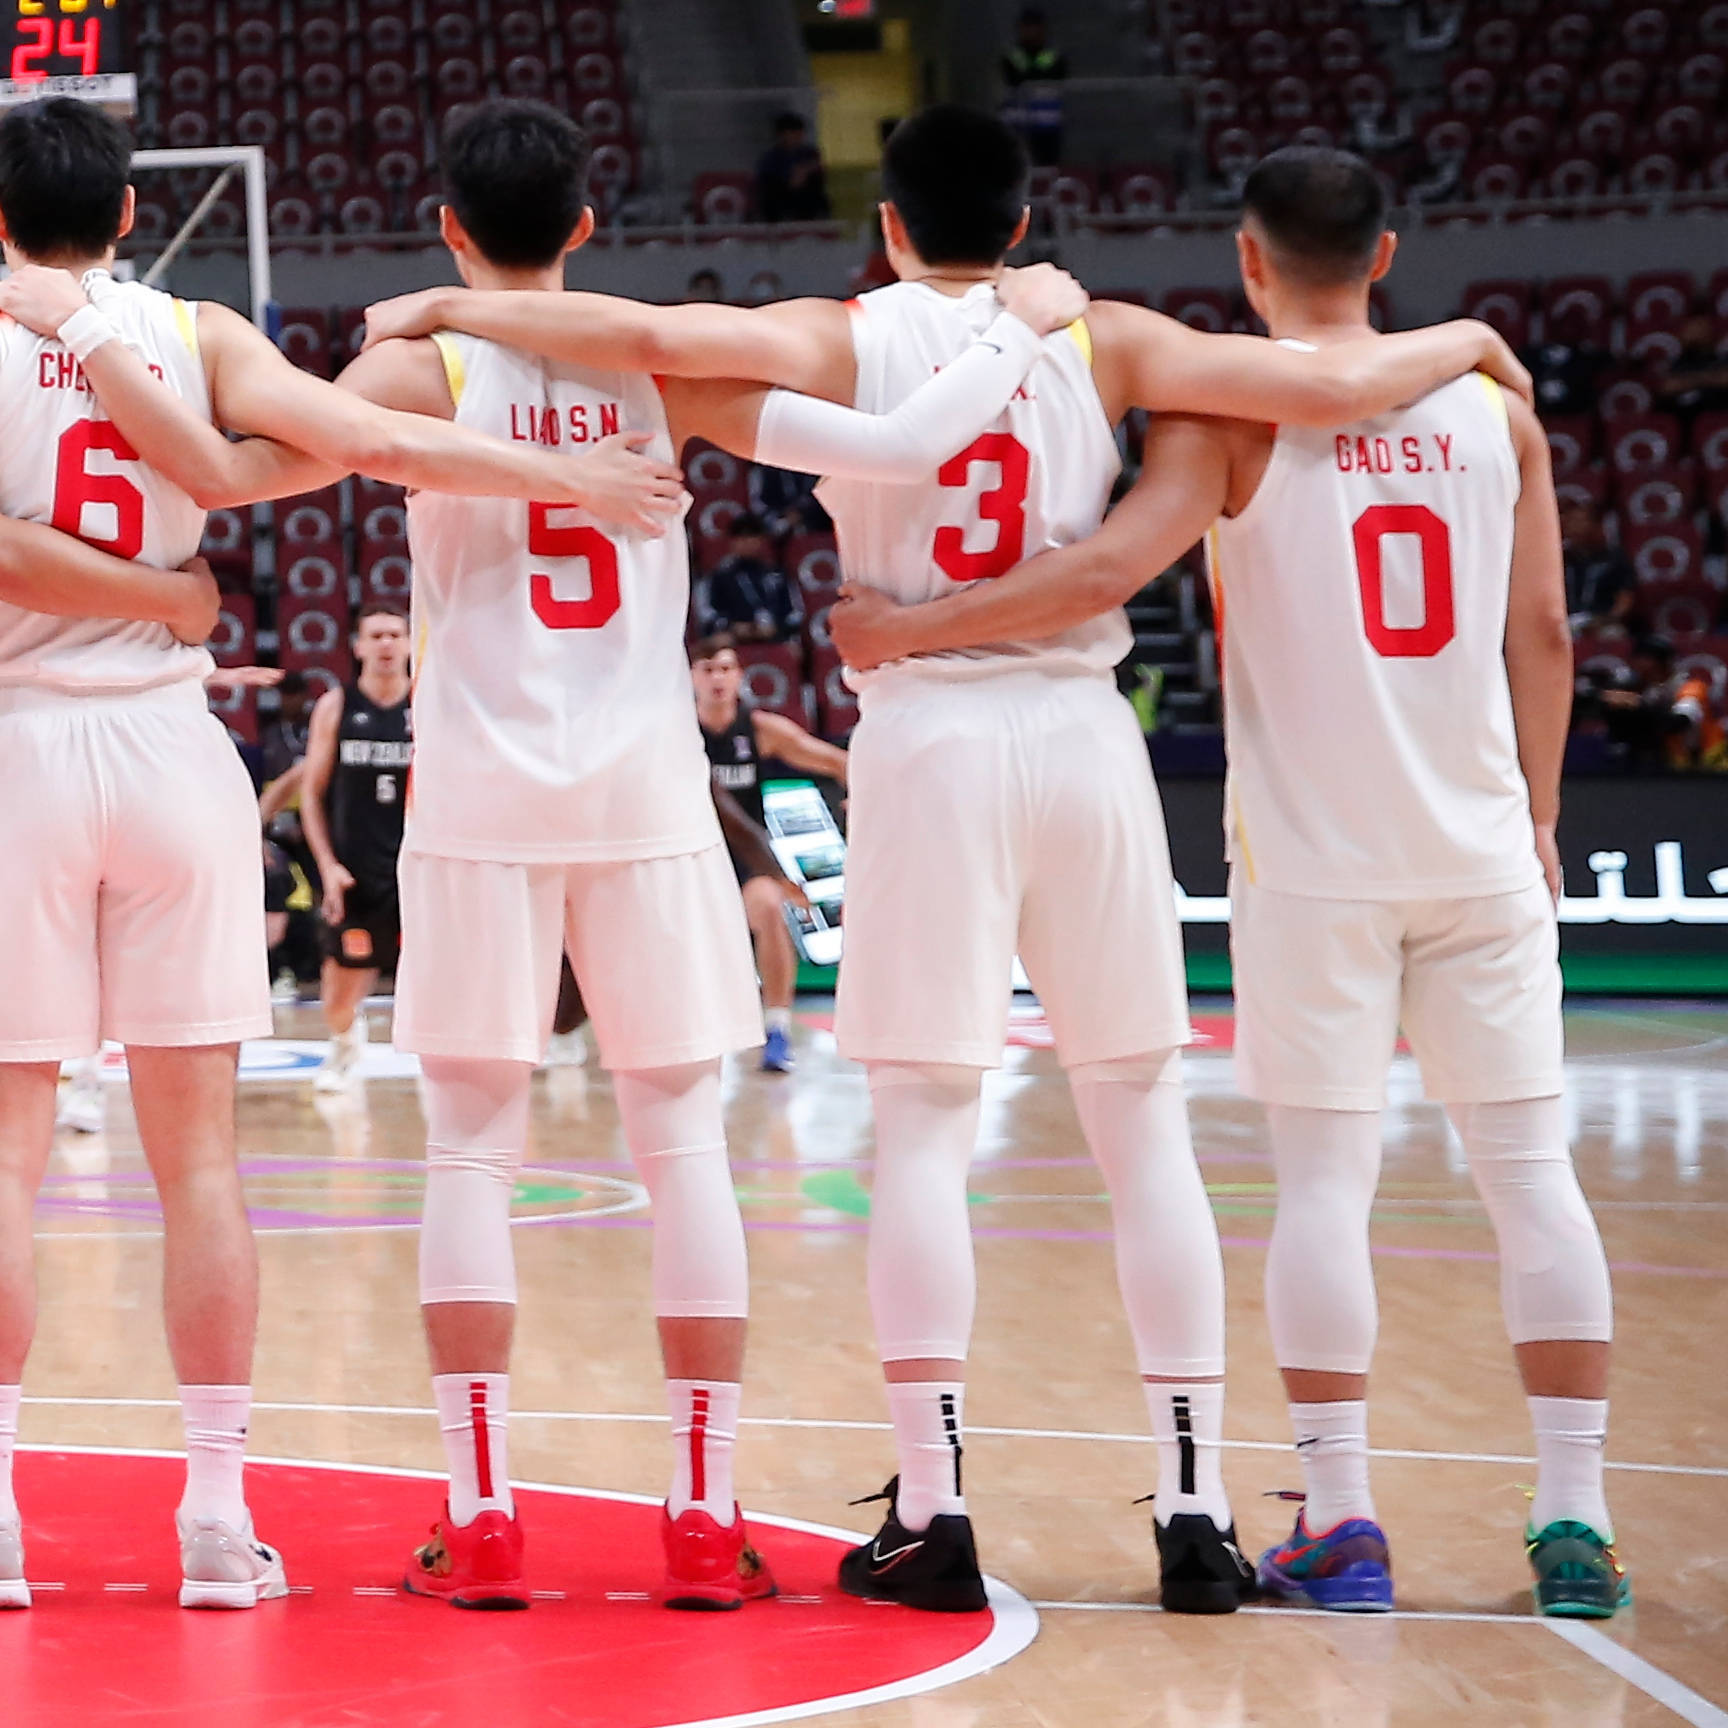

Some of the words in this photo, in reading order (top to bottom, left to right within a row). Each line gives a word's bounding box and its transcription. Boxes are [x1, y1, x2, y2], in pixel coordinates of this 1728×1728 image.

[10, 16, 101, 85] 24
[51, 417, 144, 561] 6
[933, 432, 1030, 582] 3
[529, 500, 622, 630] 5
[1352, 505, 1455, 657] 0
